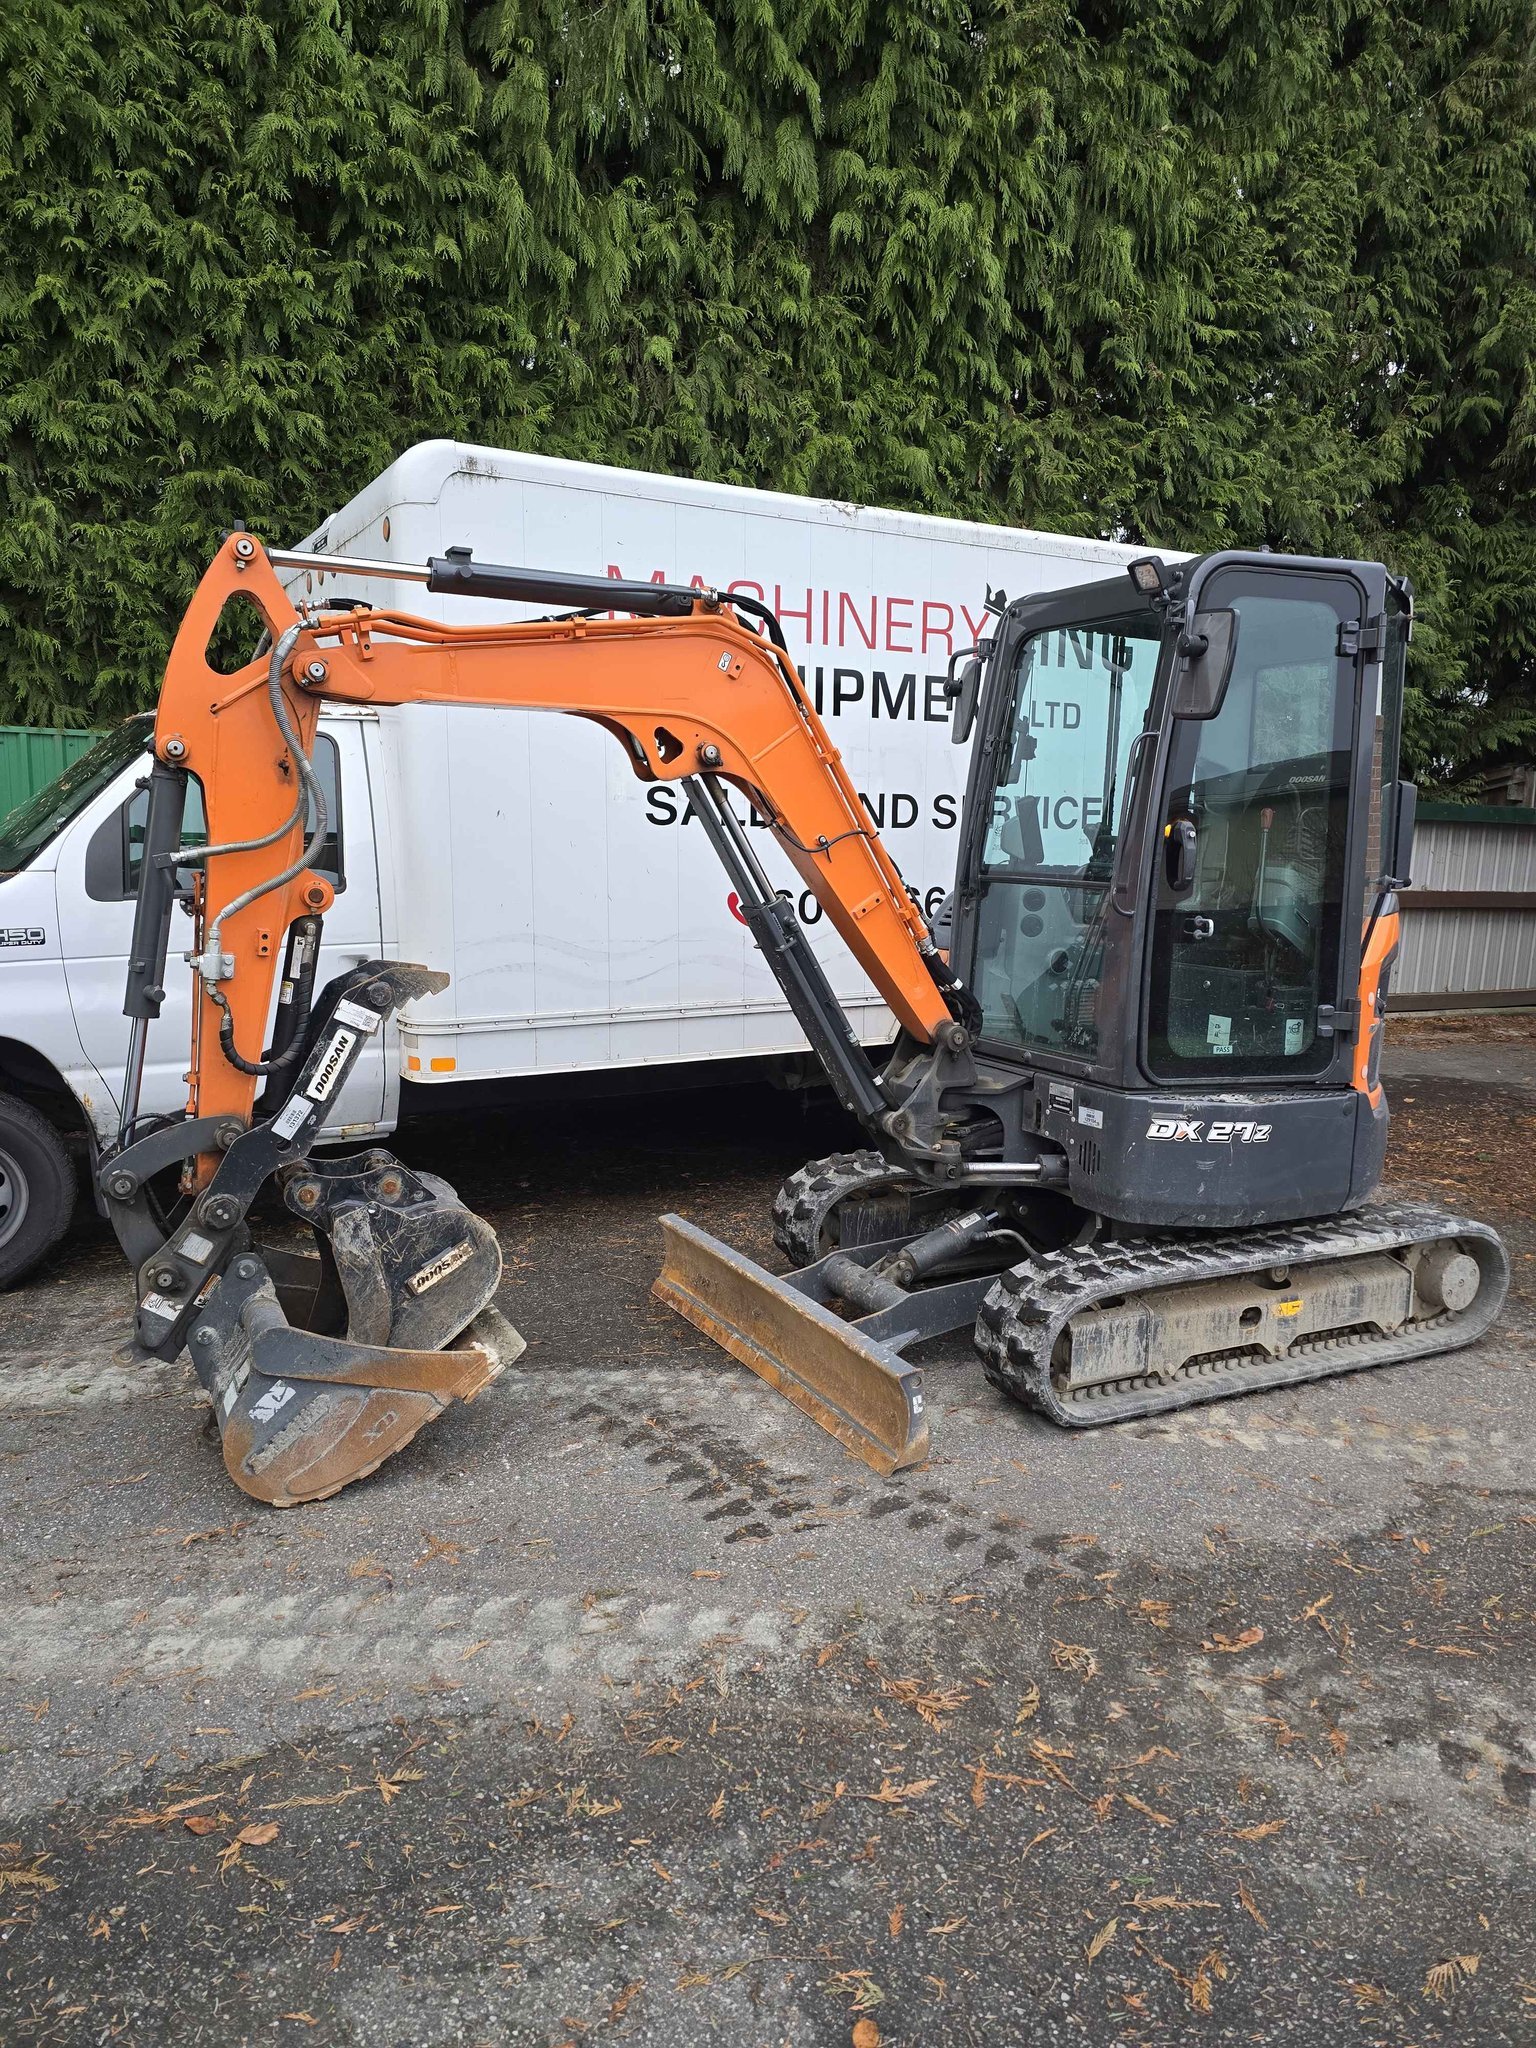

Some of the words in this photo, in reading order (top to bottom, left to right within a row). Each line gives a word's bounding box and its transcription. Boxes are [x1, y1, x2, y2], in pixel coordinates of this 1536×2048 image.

[1031, 701, 1081, 729] LTD
[1289, 775, 1326, 783] DOOSAN
[858, 793, 919, 829] ND
[931, 793, 1103, 830] SRICE
[315, 1035, 349, 1094] DOOSAN
[1146, 1118, 1204, 1142] DX
